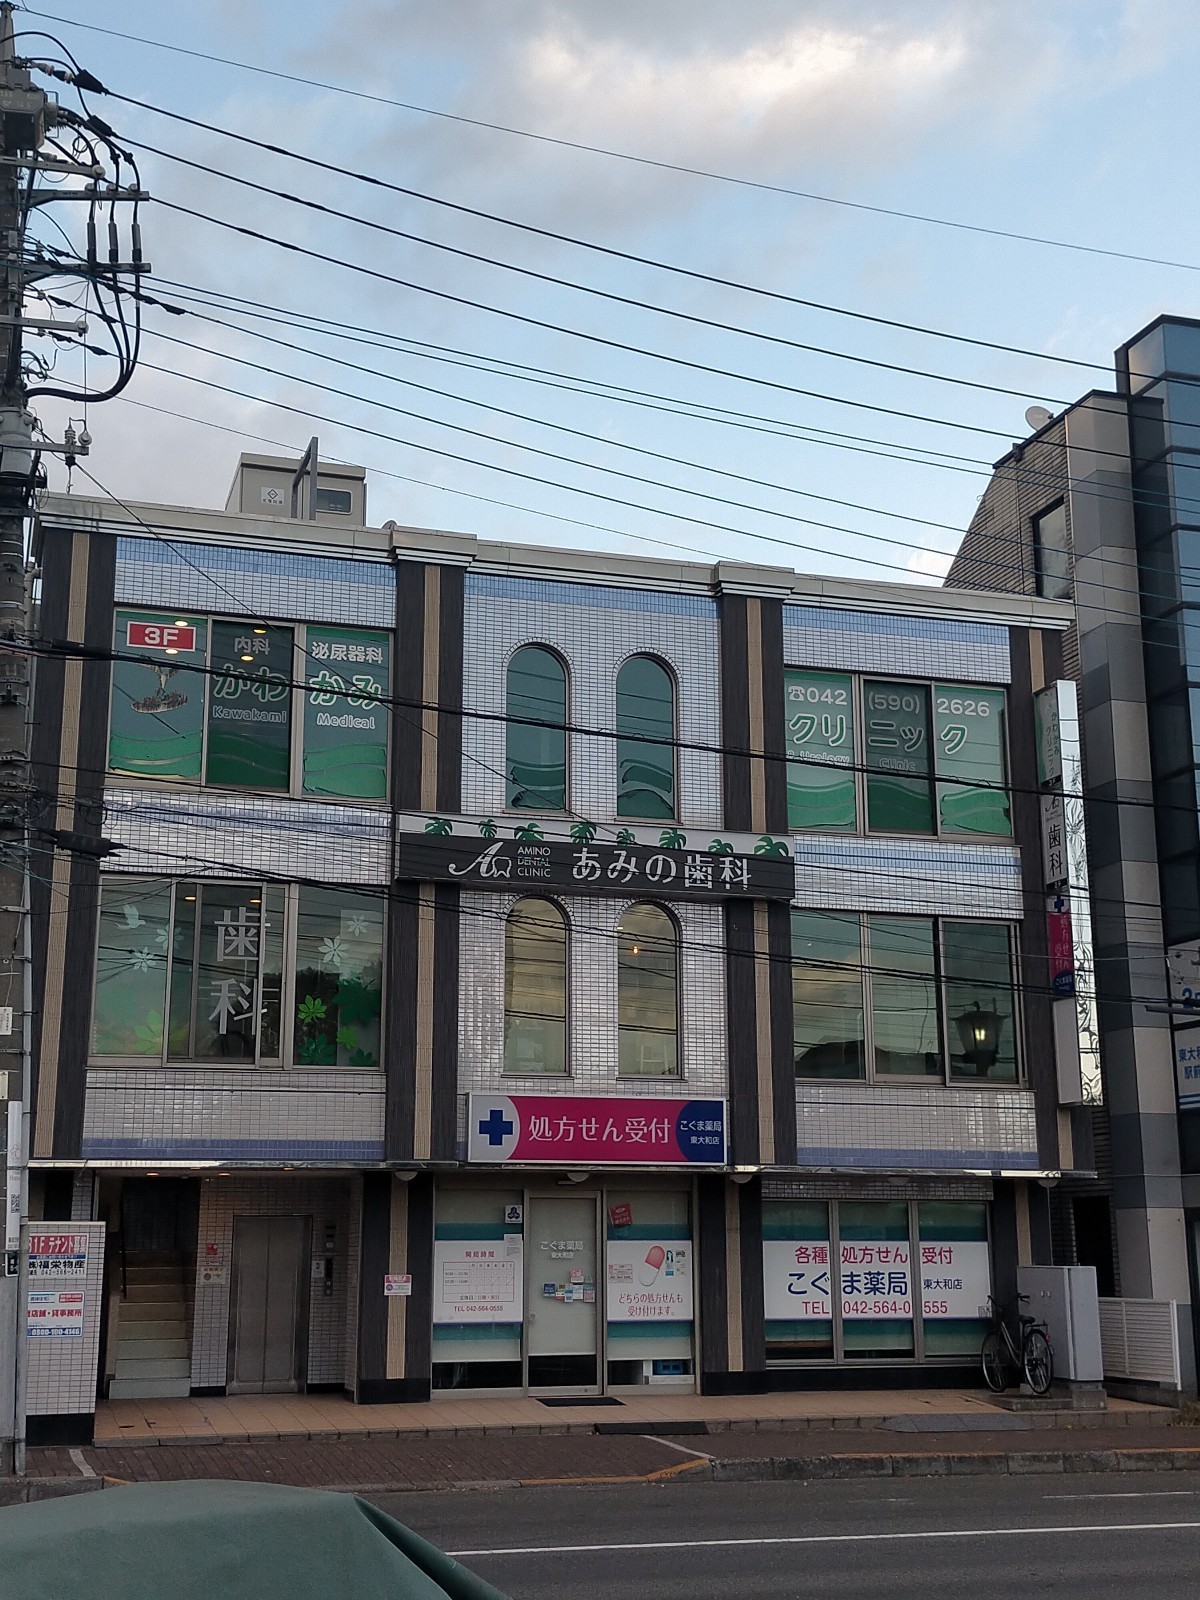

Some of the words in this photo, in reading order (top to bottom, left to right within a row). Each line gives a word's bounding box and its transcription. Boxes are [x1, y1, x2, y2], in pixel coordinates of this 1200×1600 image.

[144, 626, 179, 646] 3F
[233, 636, 270, 655] 内科
[311, 641, 383, 665] 泌尿器科
[936, 698, 990, 717] 2626
[212, 705, 287, 724] Kawakami
[316, 713, 376, 730] Medical
[879, 757, 916, 772] Clinic
[517, 845, 551, 857] AMINO
[1047, 823, 1063, 878] 歯科
[517, 856, 551, 868] DENTAL
[572, 846, 752, 891] あみの歯科
[517, 867, 551, 878] CLINIC
[208, 906, 271, 1036] 歯科
[528, 1115, 671, 1144] 処方せん受付
[680, 1120, 722, 1132] こぐま薬局
[690, 1136, 720, 1145] 東大和店
[923, 1278, 963, 1290] 東大和店
[619, 1293, 684, 1304] どちらの処方せんも
[802, 1301, 830, 1315] TEL
